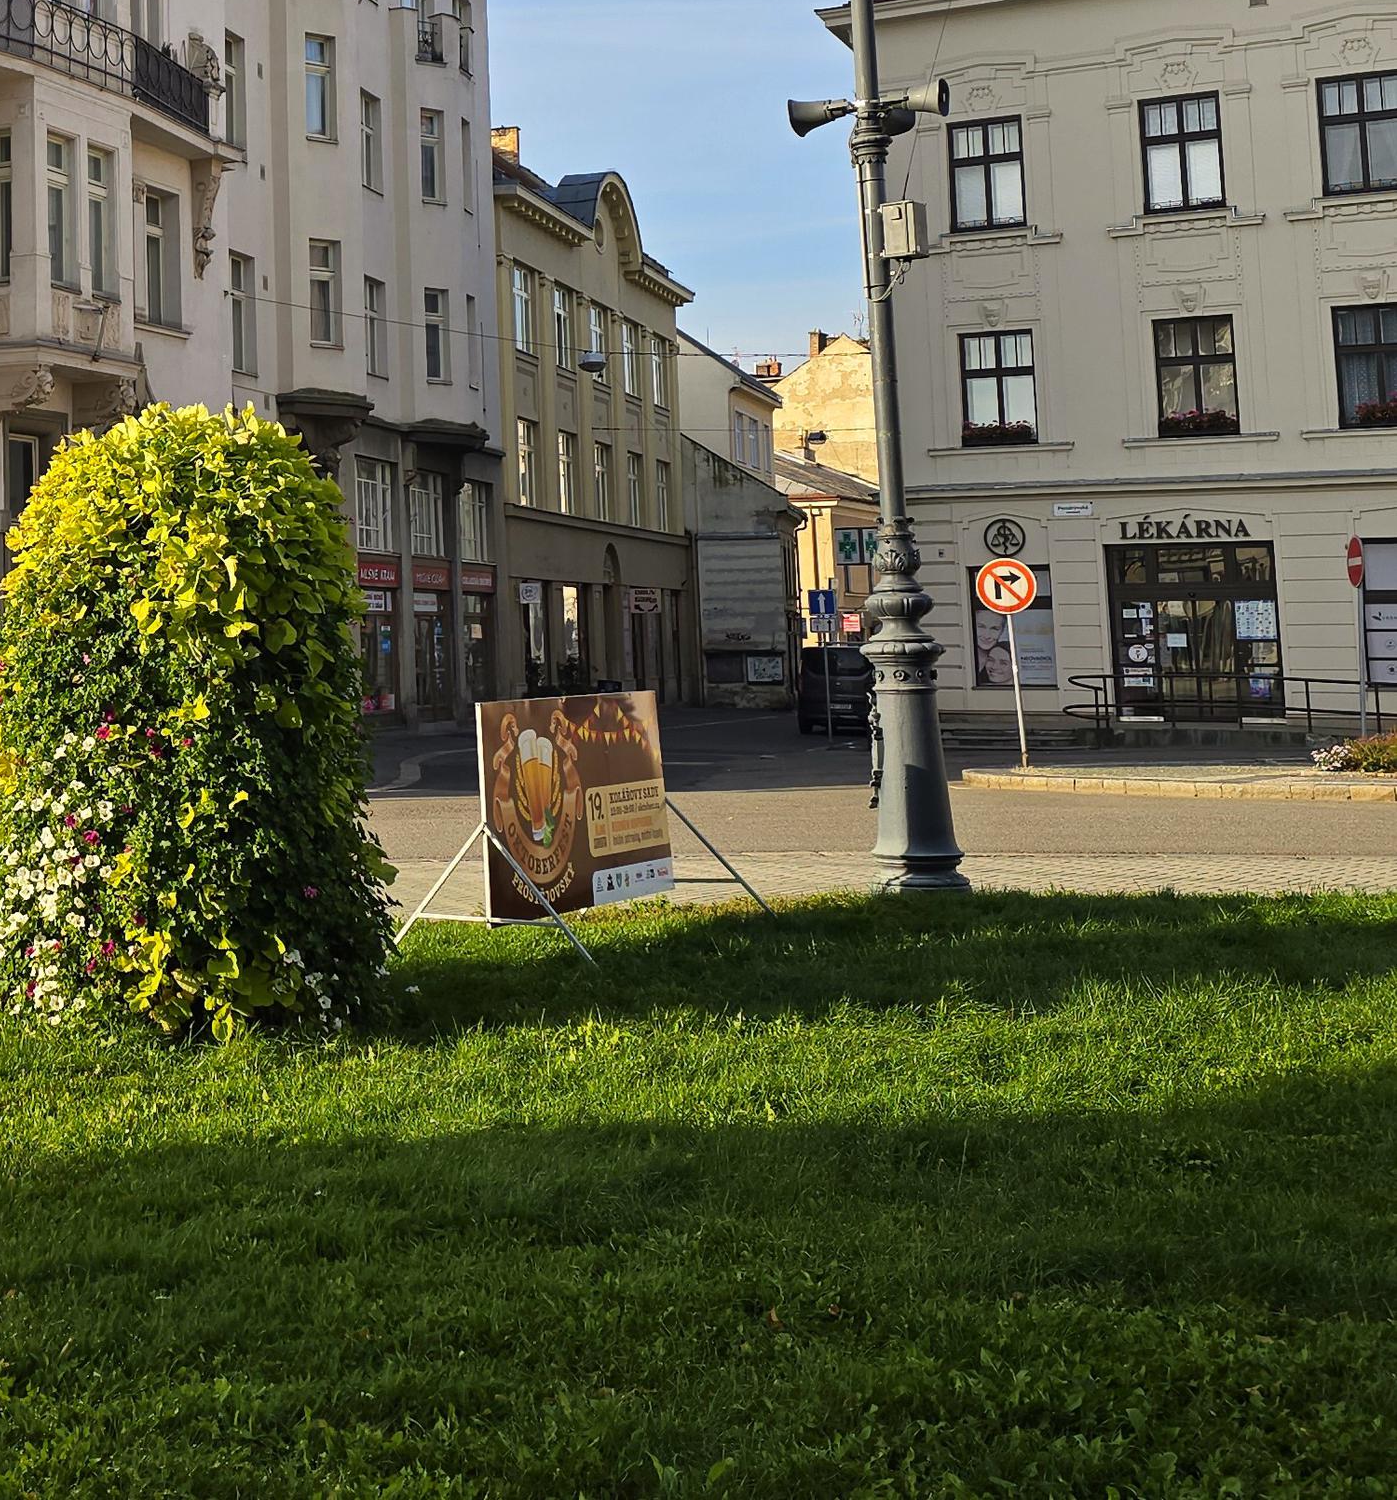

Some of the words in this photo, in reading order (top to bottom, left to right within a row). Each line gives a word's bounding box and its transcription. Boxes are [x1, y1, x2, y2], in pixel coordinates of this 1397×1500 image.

[1118, 513, 1252, 540] LÉKÁRNA
[588, 792, 604, 821] 19.
[643, 786, 659, 799] SADY
